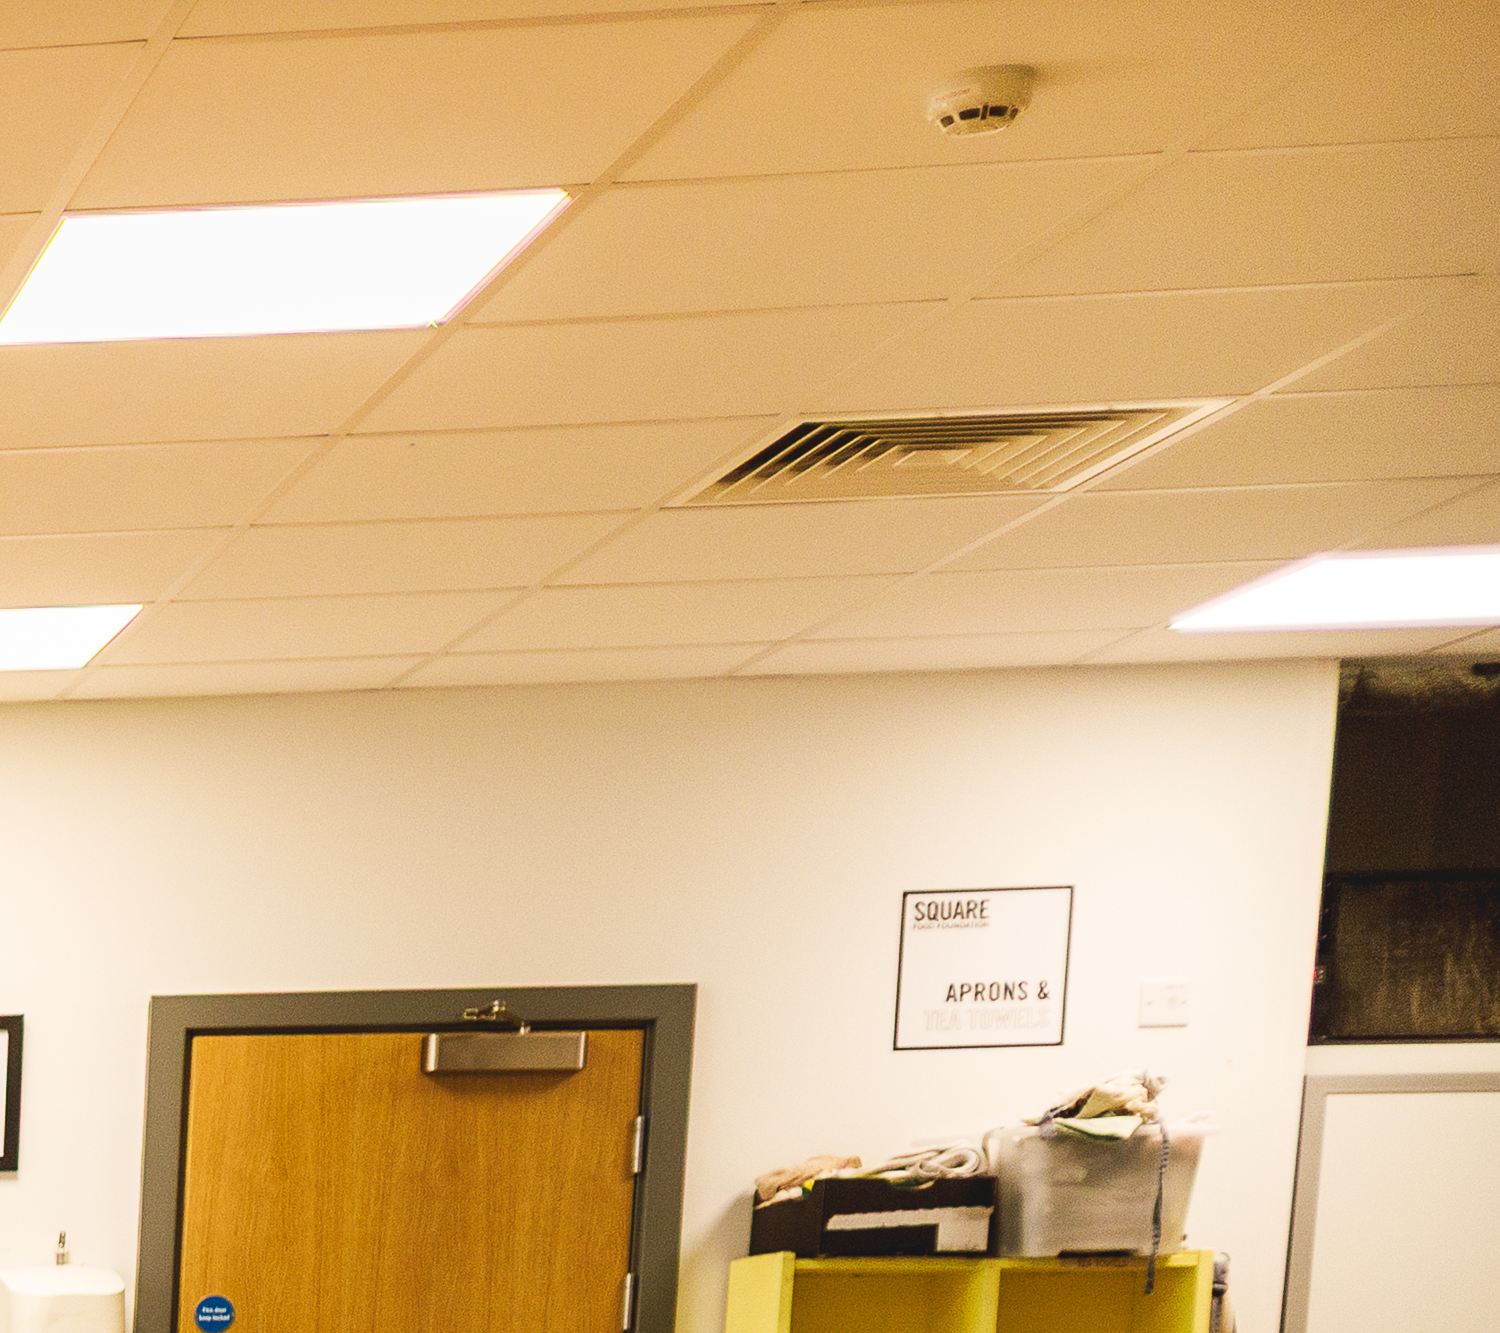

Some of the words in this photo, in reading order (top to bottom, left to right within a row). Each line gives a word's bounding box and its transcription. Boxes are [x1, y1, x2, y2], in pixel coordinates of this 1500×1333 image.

[914, 899, 990, 922] SQUARE
[913, 921, 935, 930] FOOD
[937, 920, 989, 929] FOUNDATION
[945, 981, 1028, 1003] APRONS
[1037, 980, 1050, 1000] &
[924, 1008, 961, 1032] TEA
[968, 1006, 1050, 1030] TOWELS
